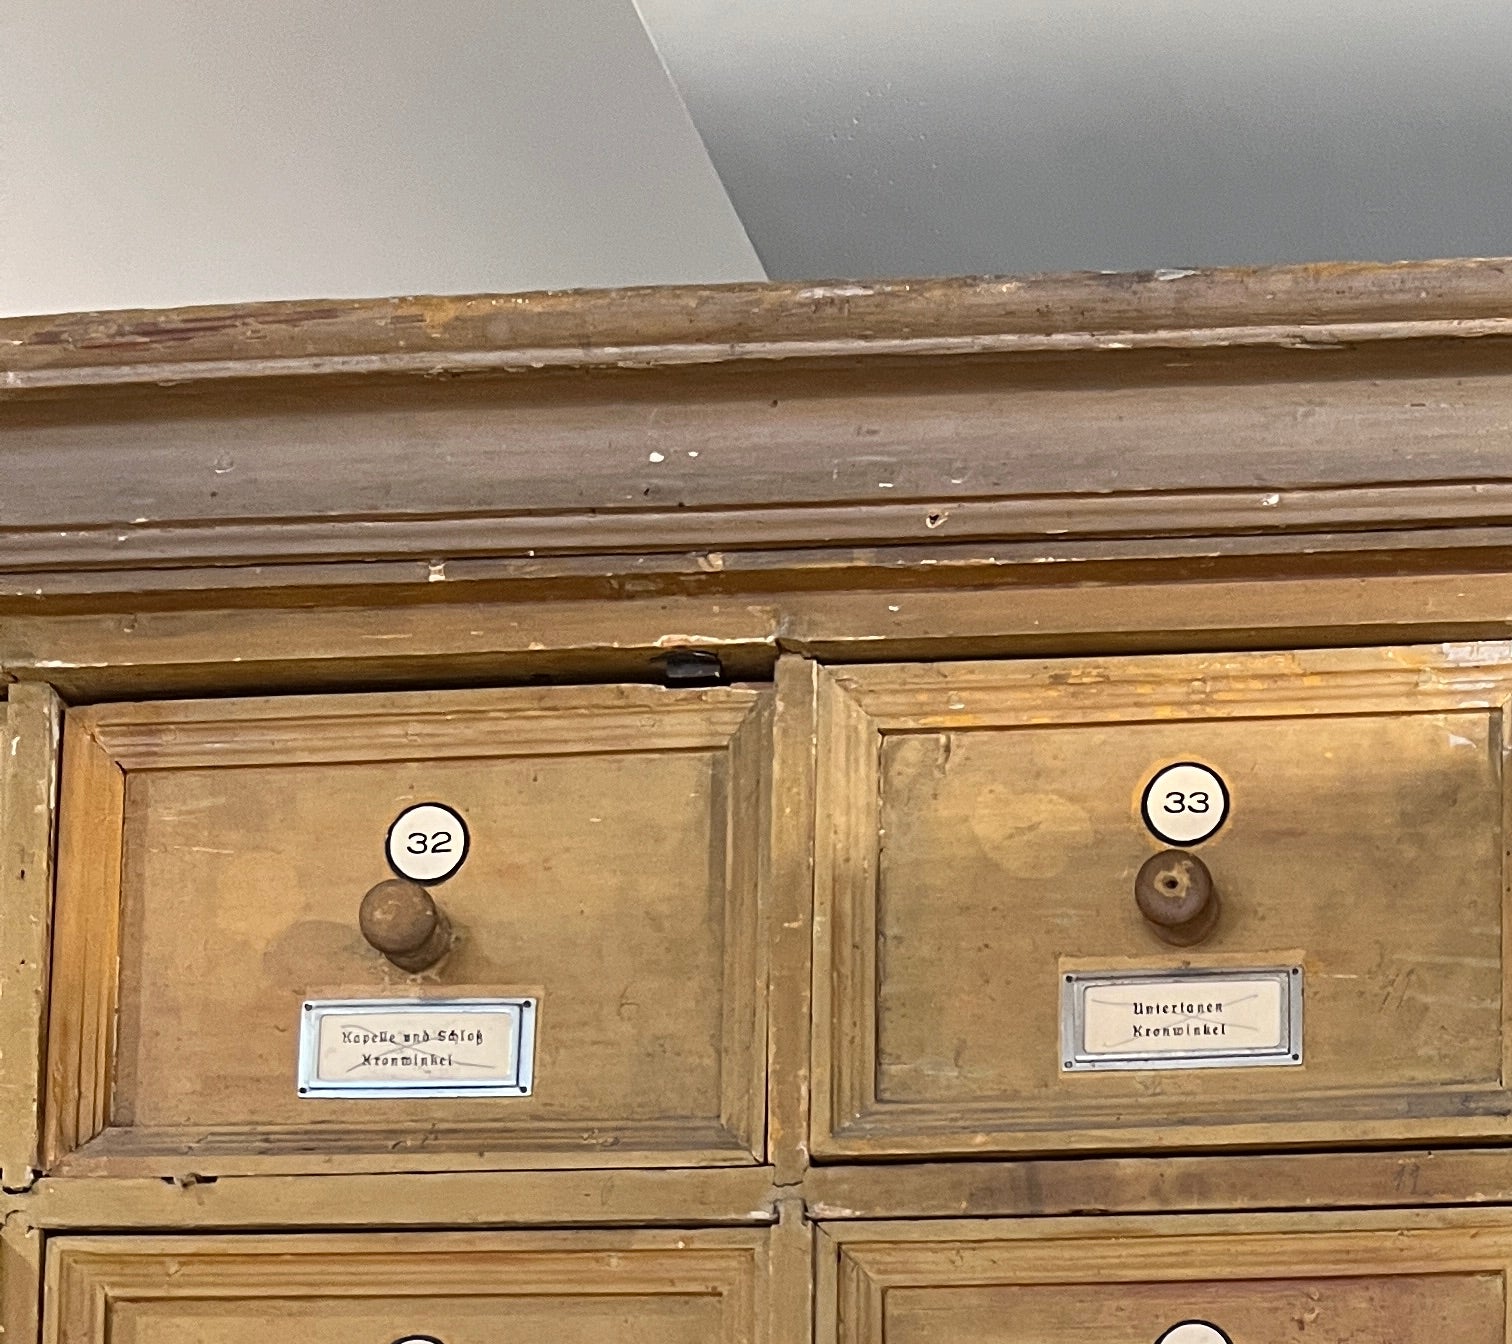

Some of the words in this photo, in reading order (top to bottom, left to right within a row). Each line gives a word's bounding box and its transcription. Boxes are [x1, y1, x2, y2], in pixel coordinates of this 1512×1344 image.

[1163, 791, 1210, 814] 33
[406, 831, 452, 855] 32
[1132, 1001, 1223, 1015] Untertanen
[342, 1031, 396, 1045] Kapelle
[403, 1029, 430, 1043] und
[437, 1029, 484, 1046] Schloß
[1132, 1023, 1226, 1038] Kronwinkel
[361, 1053, 453, 1067] Kronwinkel
